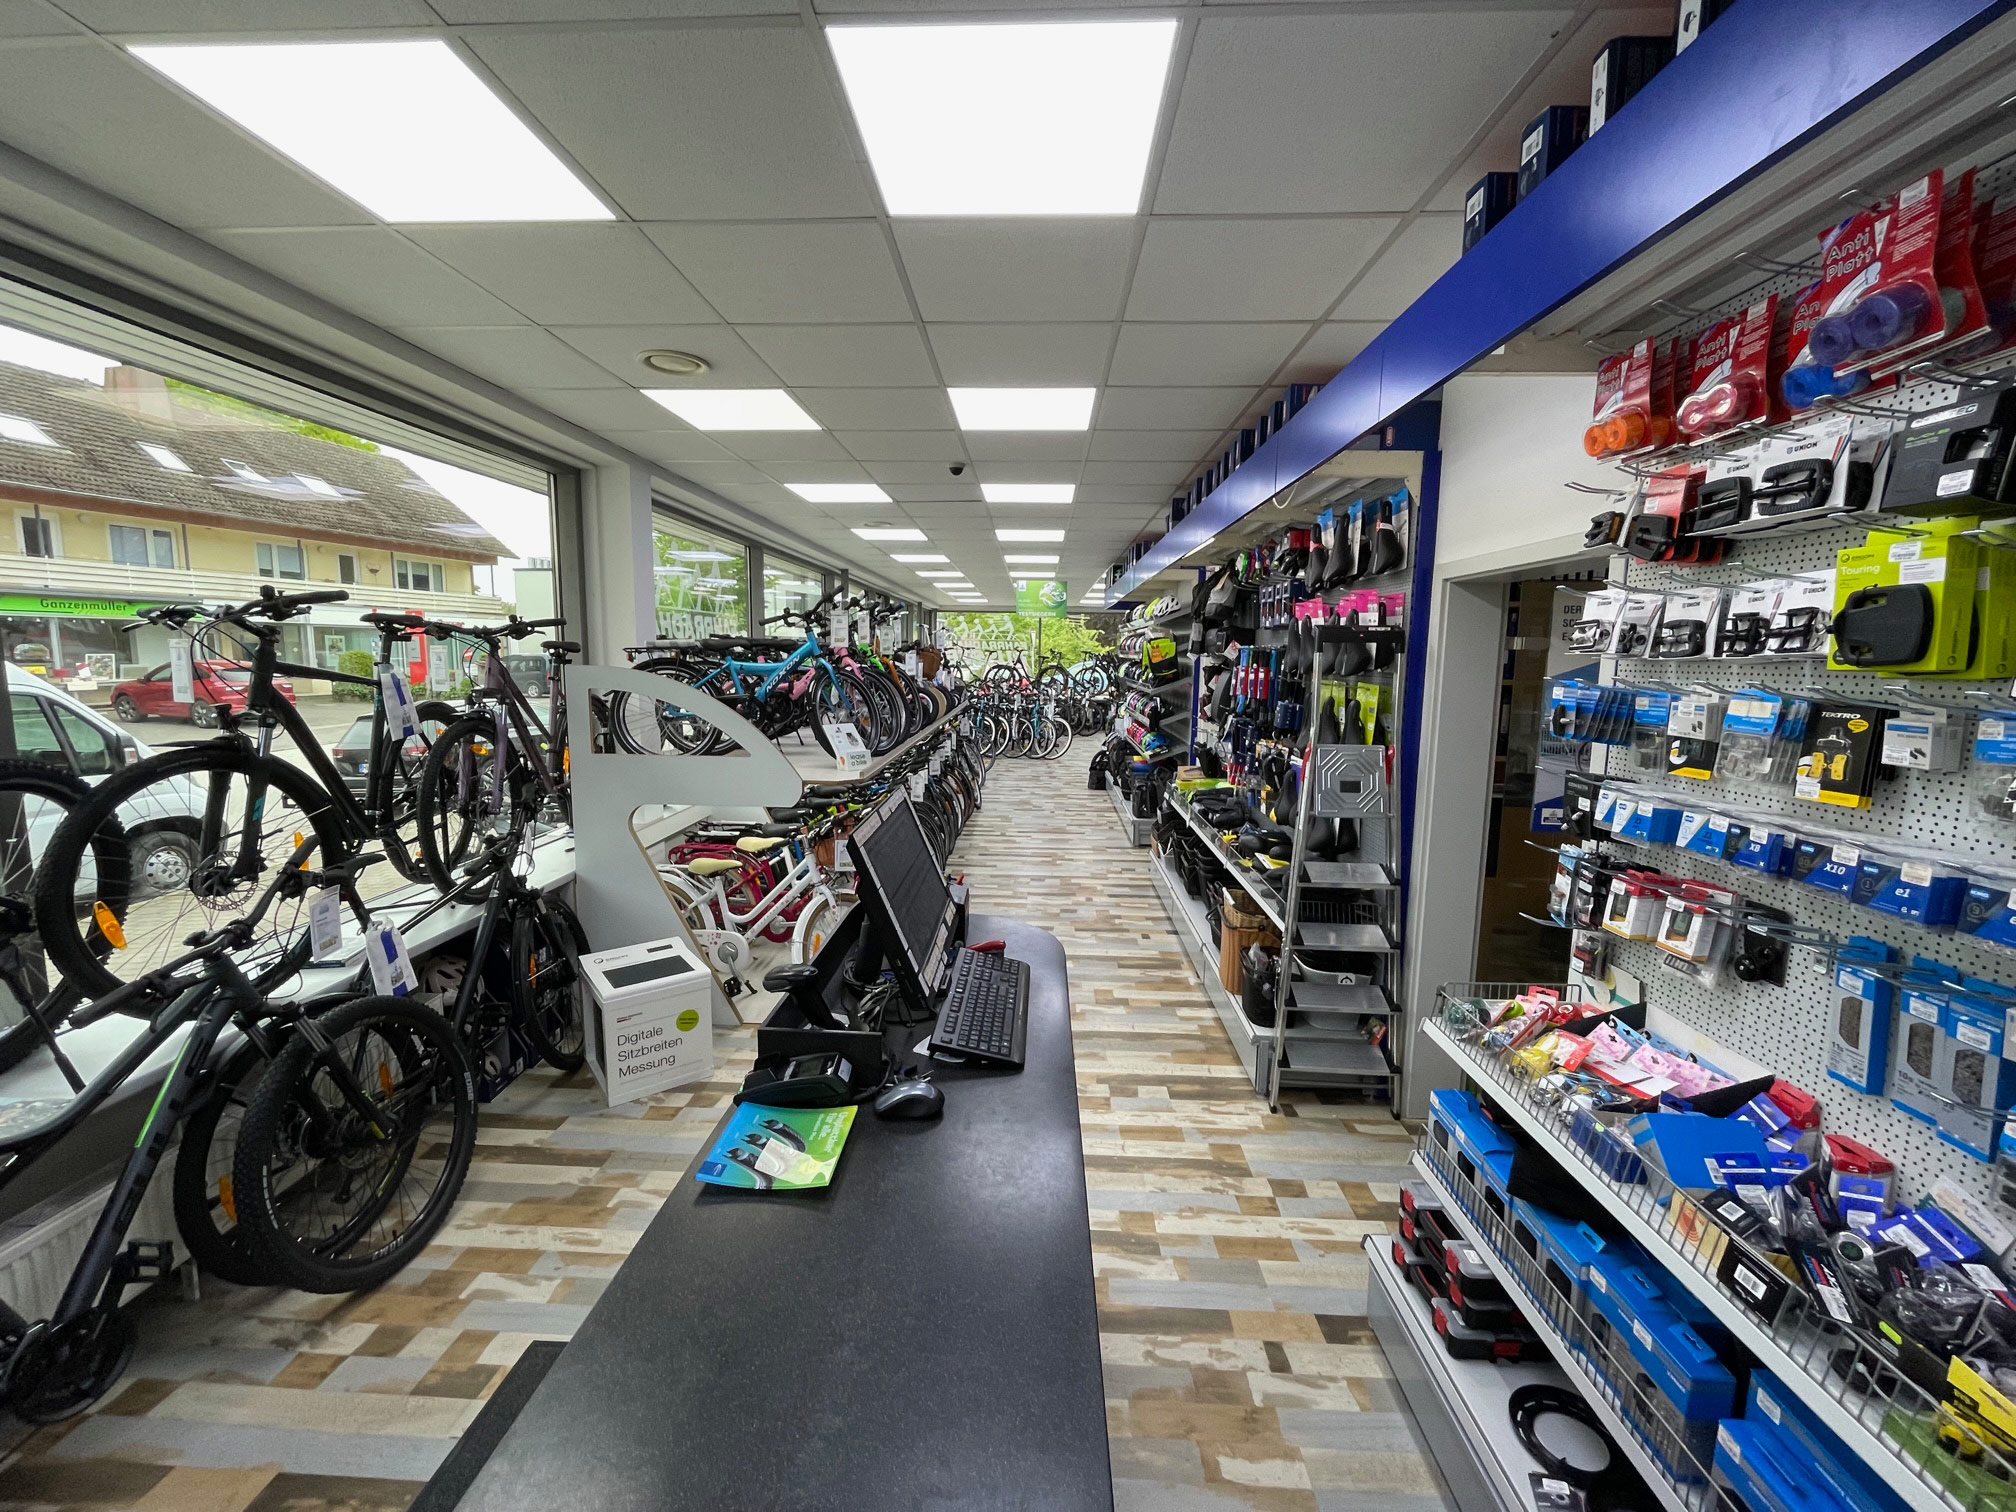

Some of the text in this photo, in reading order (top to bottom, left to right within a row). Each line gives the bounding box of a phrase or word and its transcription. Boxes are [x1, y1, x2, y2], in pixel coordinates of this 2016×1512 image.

[1826, 227, 1871, 264] Anti
[1825, 246, 1874, 282] Platt
[1795, 301, 1820, 319] An
[1793, 315, 1821, 335] Pla
[1697, 331, 1726, 358] Anti
[1794, 441, 1818, 453] UNION
[1732, 463, 1750, 473] UNION
[1840, 564, 1881, 576] Touring
[1563, 605, 1582, 615] DER
[766, 654, 801, 693] NOXON
[1820, 711, 1862, 720] TEKTRO
[1823, 862, 1846, 875] X10
[1894, 887, 1911, 898] e1
[617, 1026, 664, 1047] Digitale
[617, 1036, 683, 1063] Sitzbreiten
[618, 1054, 676, 1079] Messung
